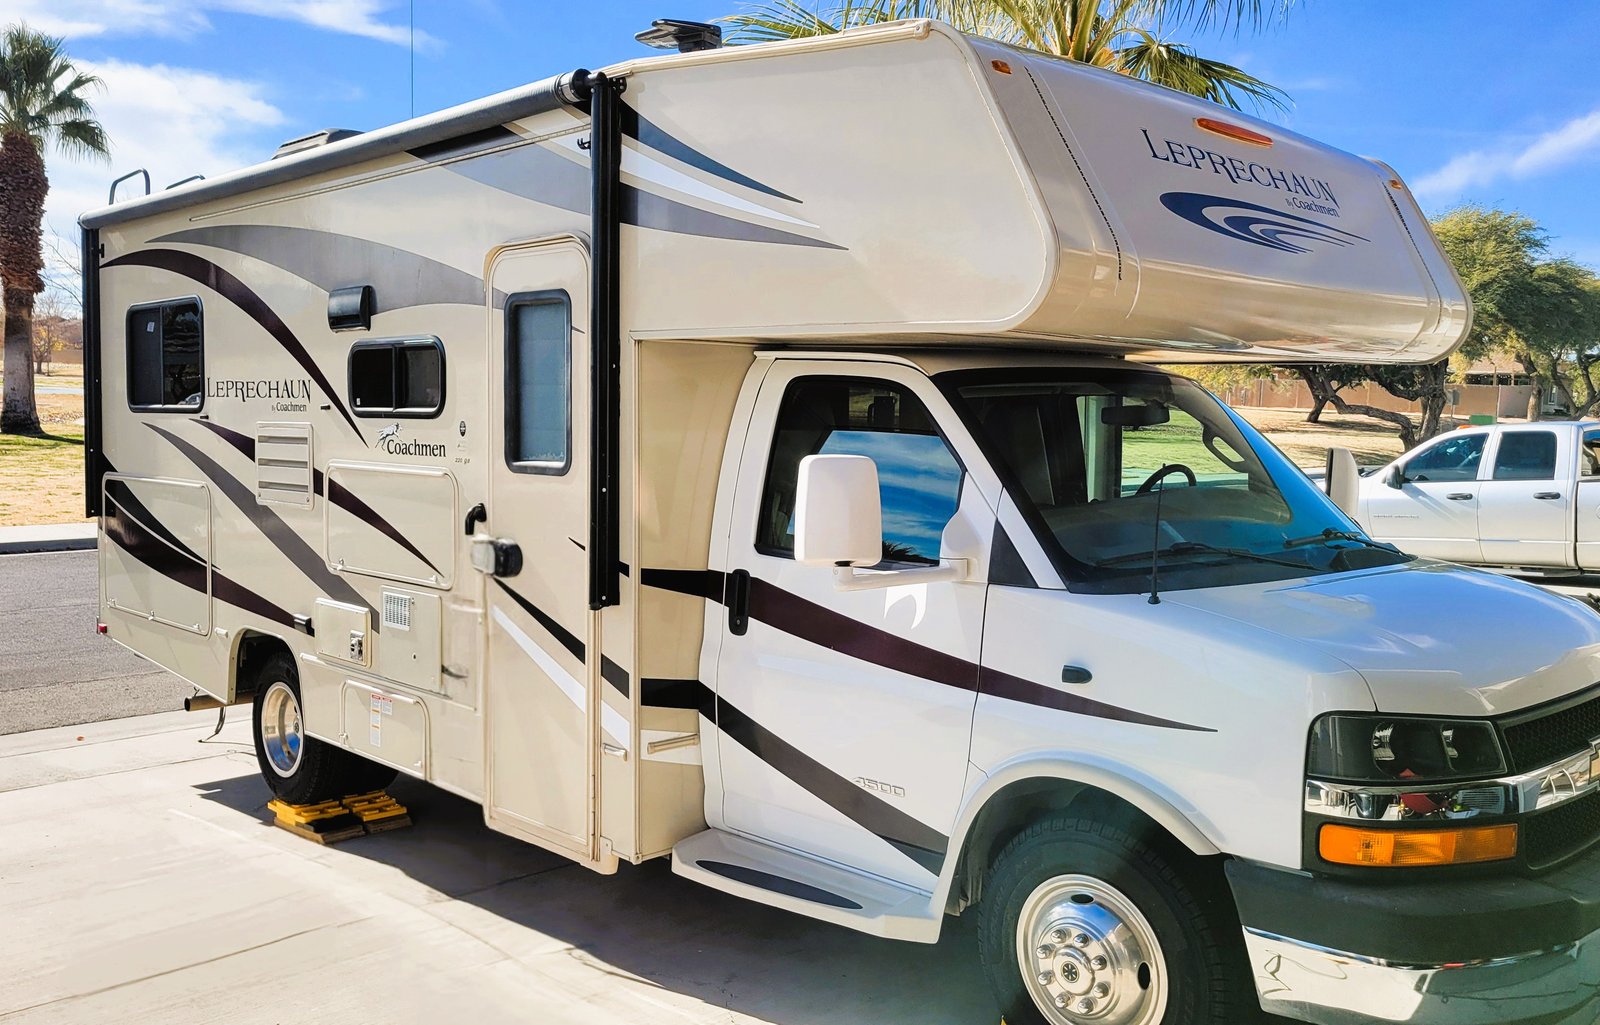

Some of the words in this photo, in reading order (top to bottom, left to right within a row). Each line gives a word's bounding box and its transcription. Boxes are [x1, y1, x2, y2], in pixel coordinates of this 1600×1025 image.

[1140, 127, 1341, 208] LEPRECHAUN
[1292, 196, 1340, 218] Coachmen
[207, 376, 311, 403] LEPRECHAUN
[276, 402, 307, 412] Coachmen
[387, 439, 446, 457] Coachmen
[852, 776, 905, 797] 4500
